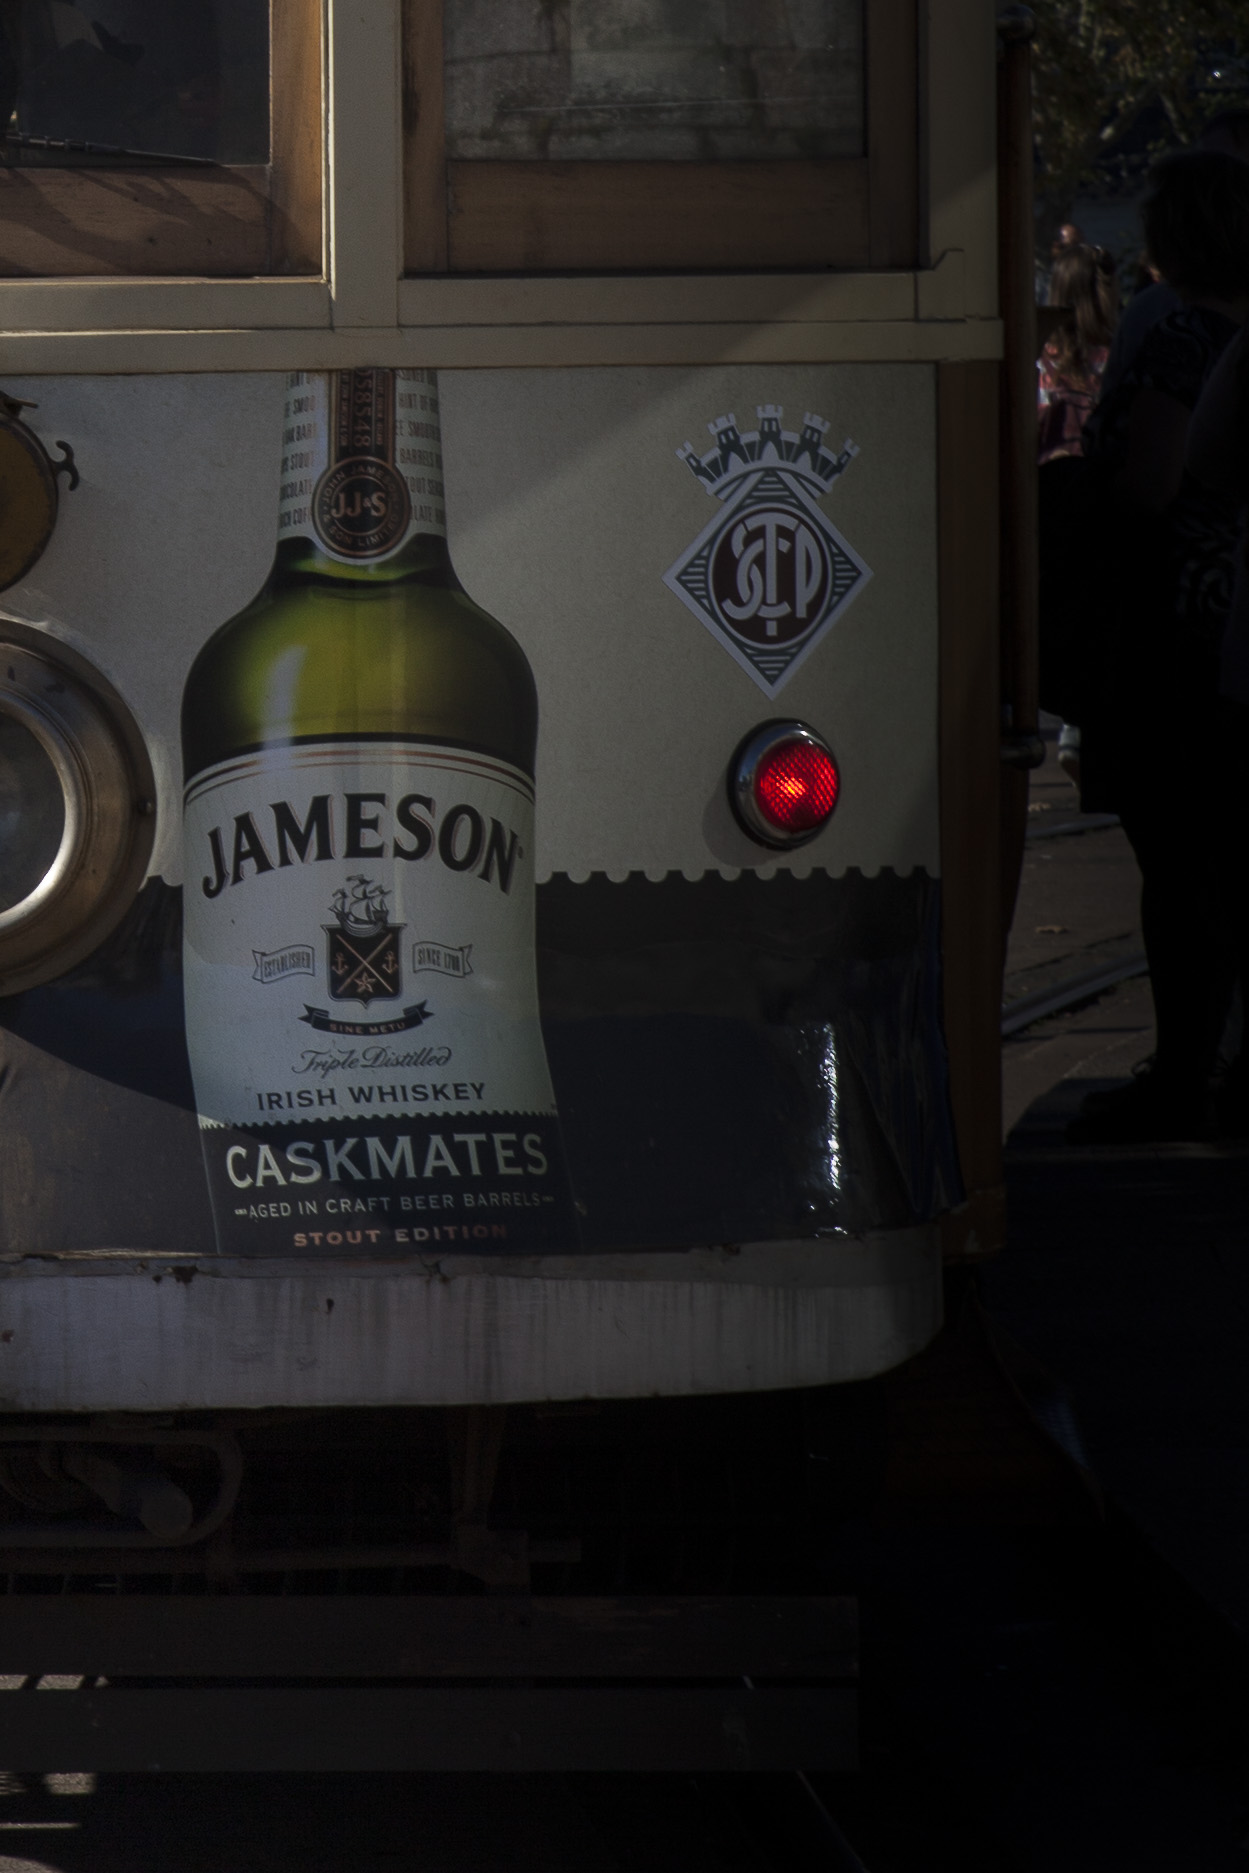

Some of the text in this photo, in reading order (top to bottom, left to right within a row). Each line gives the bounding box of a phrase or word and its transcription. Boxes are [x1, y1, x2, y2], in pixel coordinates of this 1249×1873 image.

[200, 792, 522, 900] JAMESON
[291, 1046, 454, 1079] Triple Distilled
[257, 1082, 487, 1112] IRISH WHISKEY
[225, 1131, 550, 1190] CASKMATES
[249, 1191, 542, 1220] AGED IN CRAFT BEER BARRELS
[293, 1223, 510, 1248] STOUT EDITION
